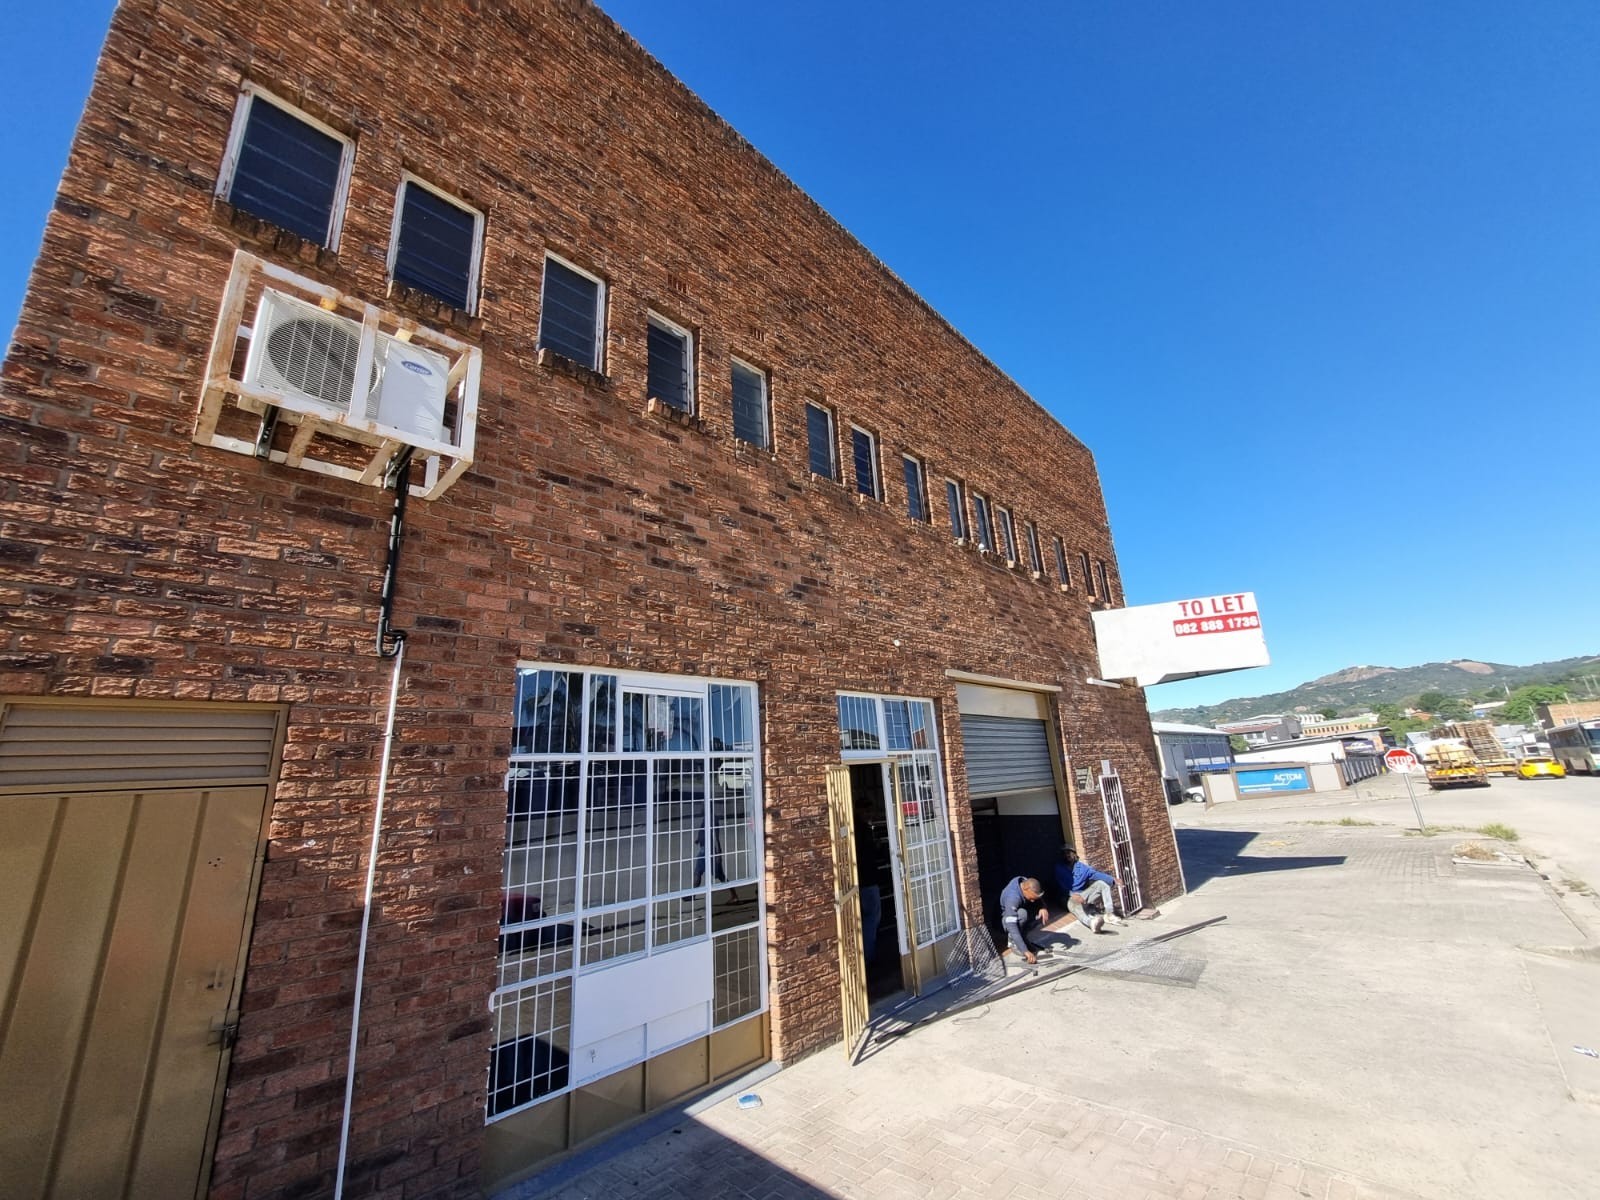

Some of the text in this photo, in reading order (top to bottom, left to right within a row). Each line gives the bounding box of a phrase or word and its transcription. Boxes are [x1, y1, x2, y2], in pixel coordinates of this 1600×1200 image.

[1178, 595, 1245, 617] TO LET
[1175, 622, 1199, 634] 082
[1387, 755, 1413, 768] STOP
